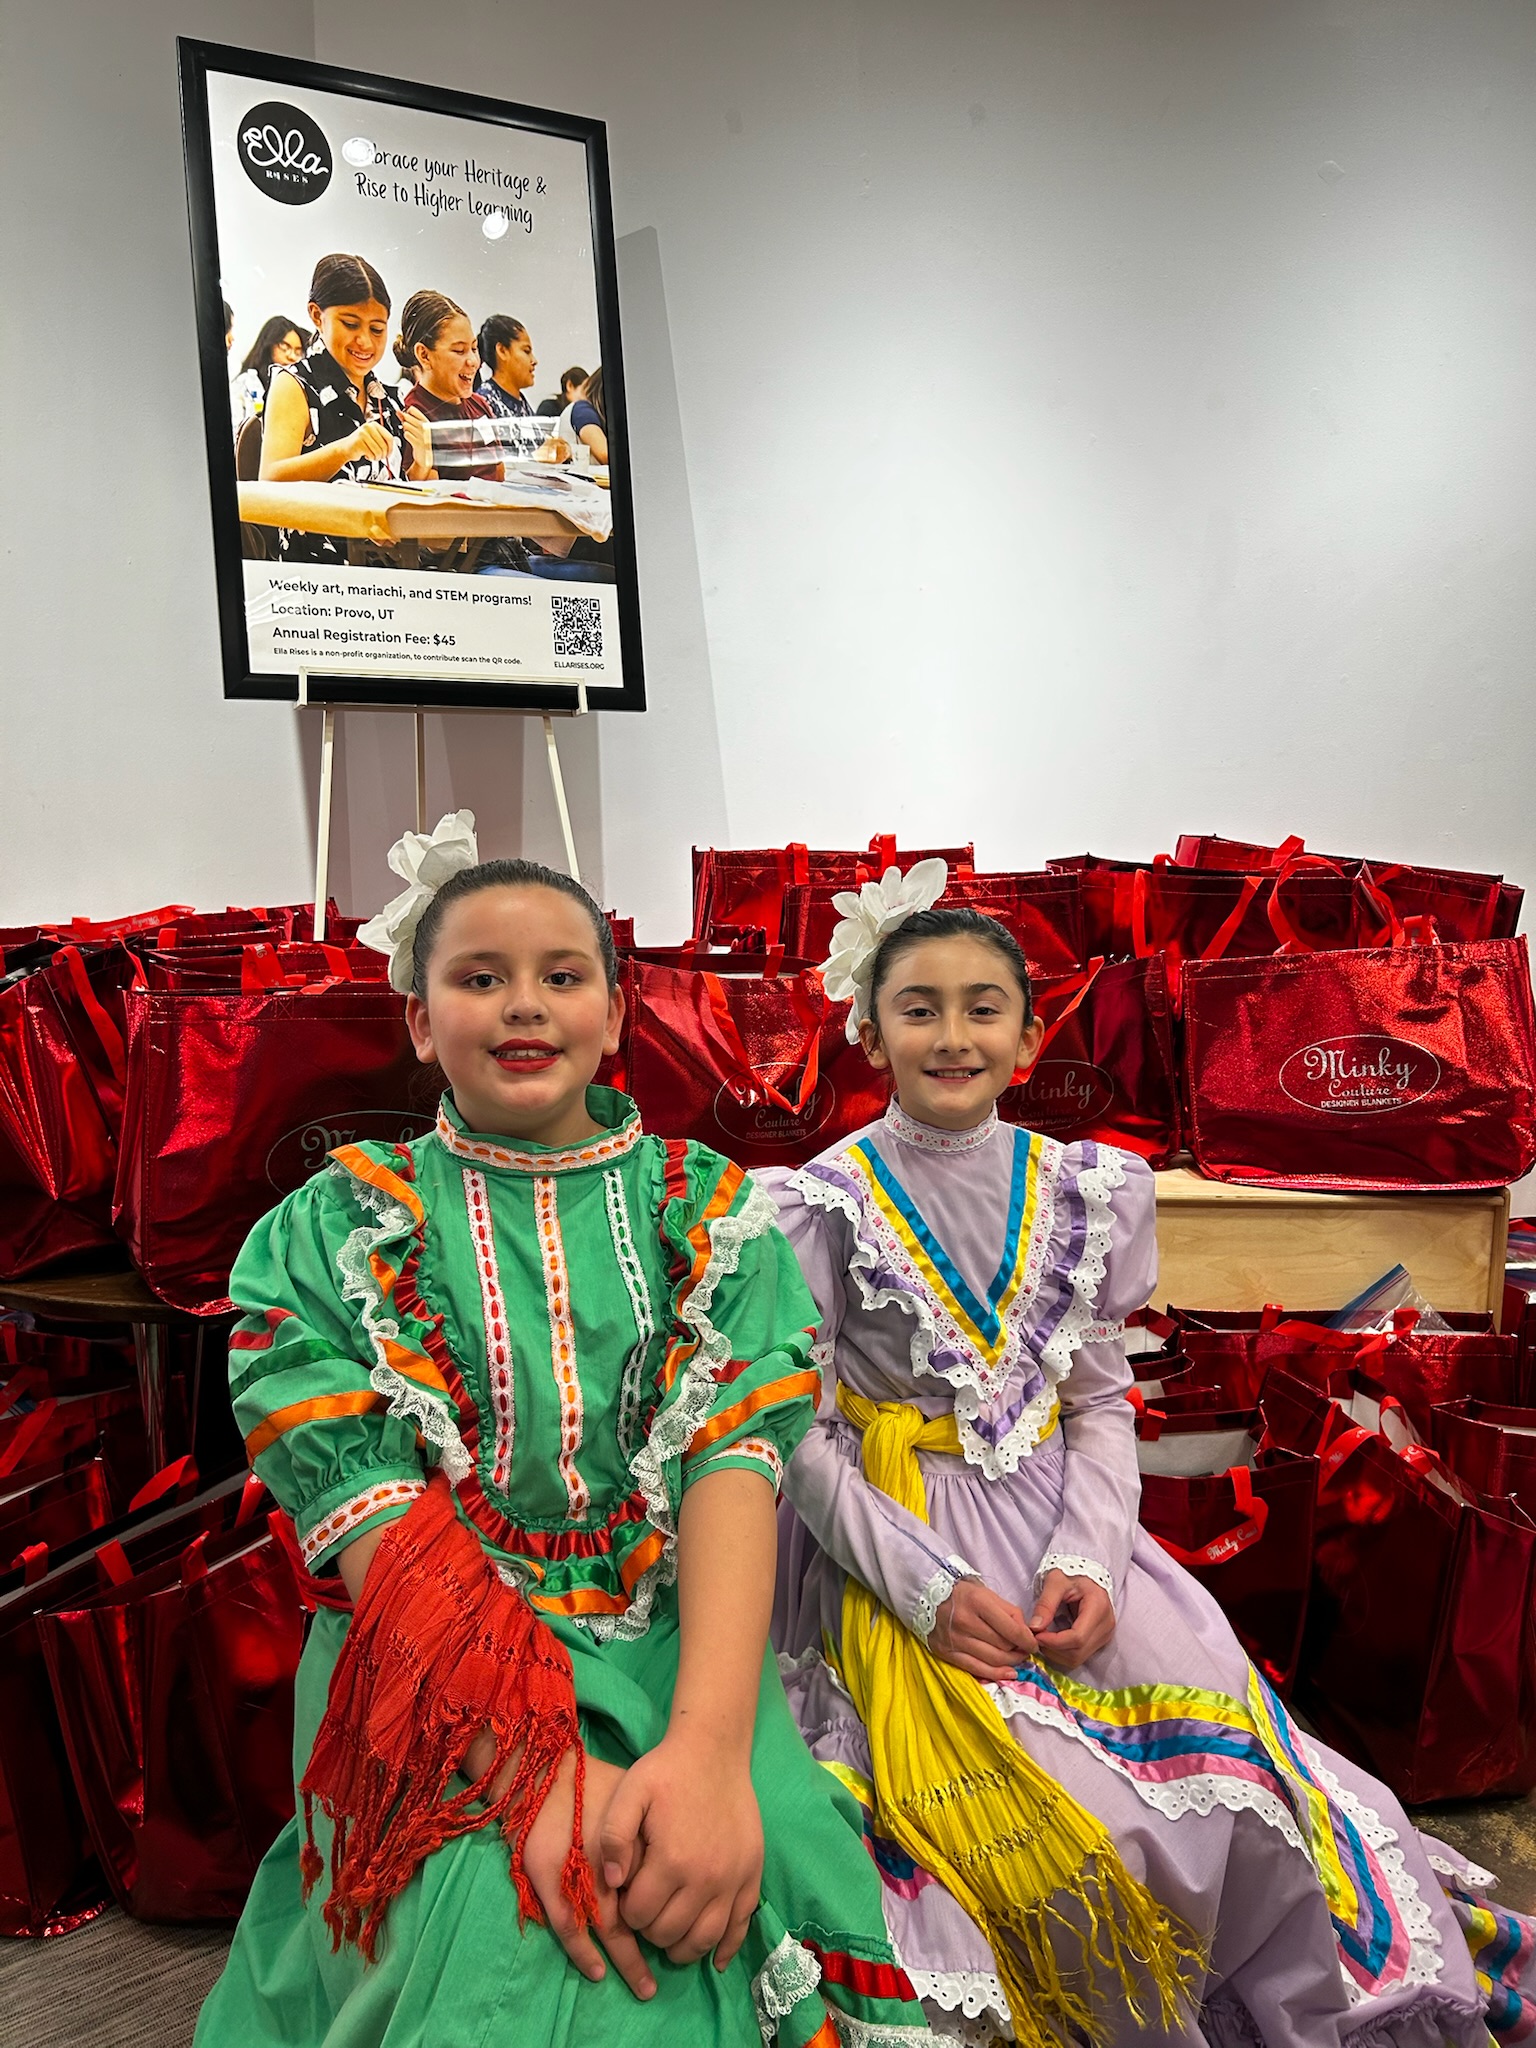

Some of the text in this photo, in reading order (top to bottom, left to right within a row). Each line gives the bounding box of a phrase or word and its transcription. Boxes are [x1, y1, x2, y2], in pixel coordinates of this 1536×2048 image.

[242, 124, 329, 175] Ella
[360, 141, 547, 200] brace your Heritage &
[354, 172, 387, 199] Rise
[392, 182, 408, 203] to
[413, 182, 464, 217] Higher
[269, 579, 532, 606] Weekly art, mariachi, and STEM programs!
[271, 603, 395, 621] Location: Provo, UT
[272, 627, 456, 647] Annual Registration Fee: $45
[273, 647, 288, 655] Ella
[289, 648, 309, 656] Rises
[311, 648, 317, 656] is
[325, 650, 364, 658] non-profit
[365, 652, 413, 660] organization,
[422, 654, 460, 662] contribute
[492, 657, 503, 666] QR
[554, 661, 605, 670] ELLARISES.ORG
[1303, 1046, 1418, 1090] Minky
[1328, 1078, 1391, 1098] Couture
[1320, 1097, 1402, 1109] DESIGNER BLANKETS
[755, 1108, 802, 1129] Couture
[745, 1128, 807, 1140] DESIGNER BLANKETS
[1207, 1537, 1239, 1561] Minky
